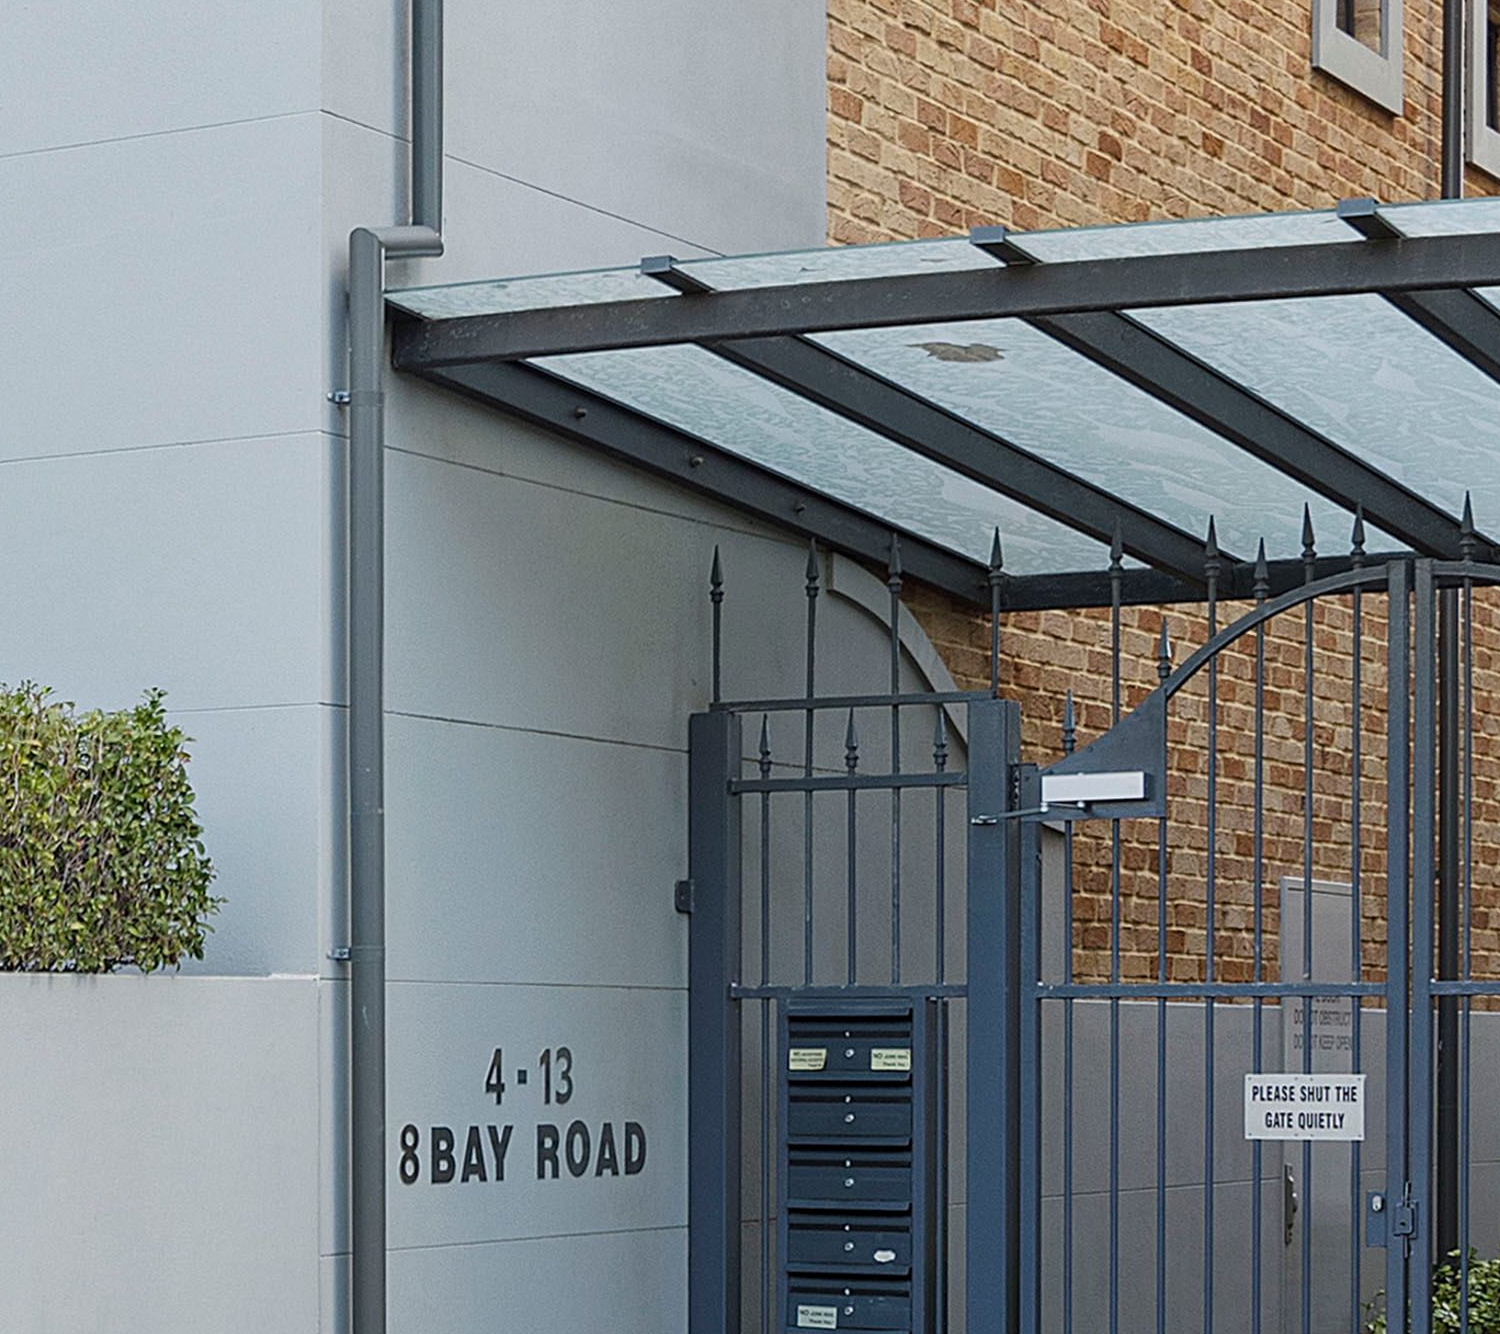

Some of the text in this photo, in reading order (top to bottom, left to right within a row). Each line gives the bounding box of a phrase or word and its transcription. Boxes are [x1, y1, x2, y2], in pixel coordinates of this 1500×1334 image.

[1251, 1085, 1358, 1103] PLEASE SHUT THE
[1264, 1112, 1345, 1130] GATE QUIETLY
[399, 1119, 647, 1186] 8 BAY ROAD
